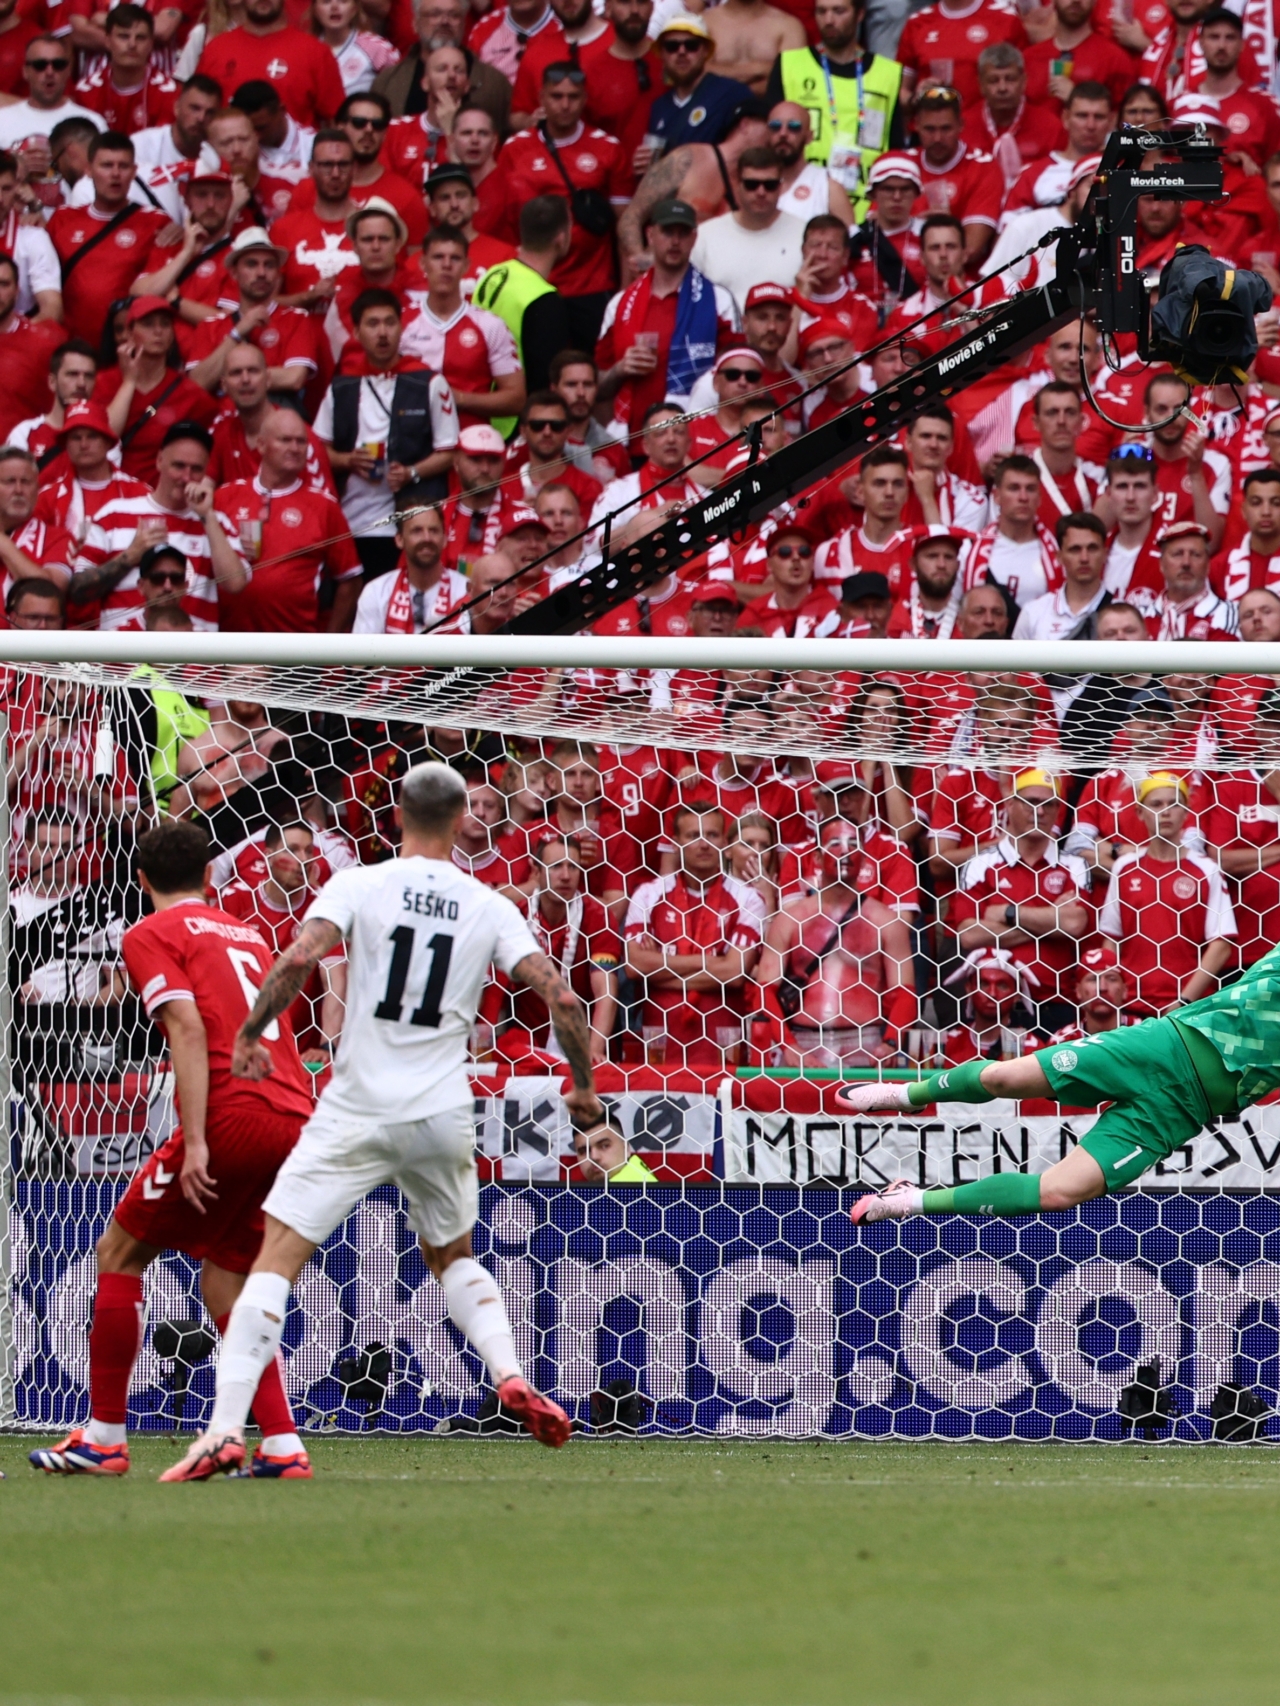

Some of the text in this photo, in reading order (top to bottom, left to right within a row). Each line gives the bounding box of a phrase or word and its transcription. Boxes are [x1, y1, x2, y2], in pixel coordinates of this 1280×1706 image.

[1130, 177, 1185, 186] MovieTech
[1121, 236, 1134, 274] P10
[703, 480, 761, 524] MovieTh
[622, 783, 640, 817] 9
[403, 886, 459, 921] ŠEŠKO
[374, 925, 455, 1029] 11
[746, 1116, 1029, 1185] MORTEN
[1113, 1145, 1143, 1170] 1
